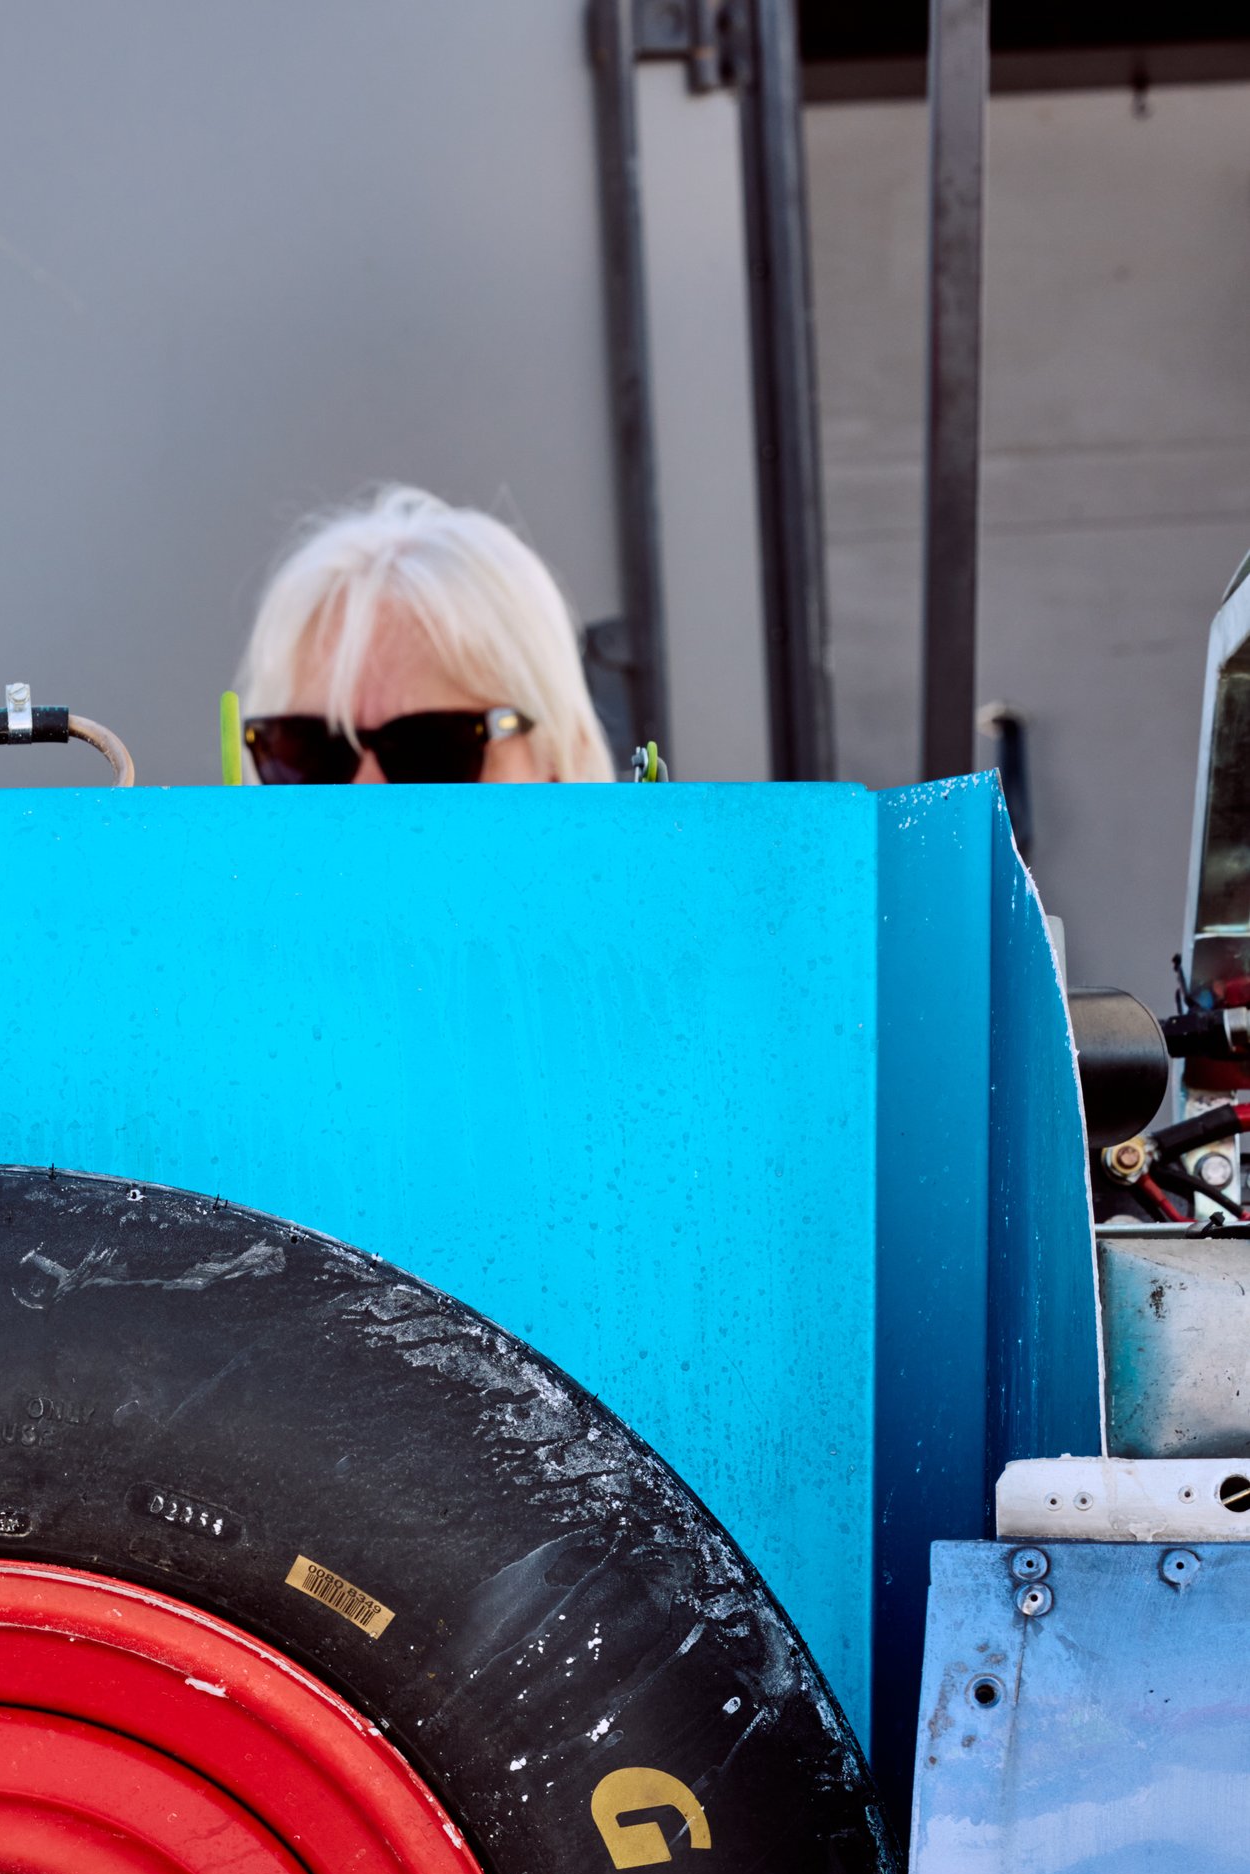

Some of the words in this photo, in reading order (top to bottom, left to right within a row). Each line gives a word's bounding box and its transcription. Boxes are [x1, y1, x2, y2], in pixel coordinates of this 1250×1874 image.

[26, 1396, 96, 1426] ONLY
[0, 1422, 54, 1448] USE
[307, 1563, 345, 1590] 0080
[346, 1586, 383, 1615] 8349
